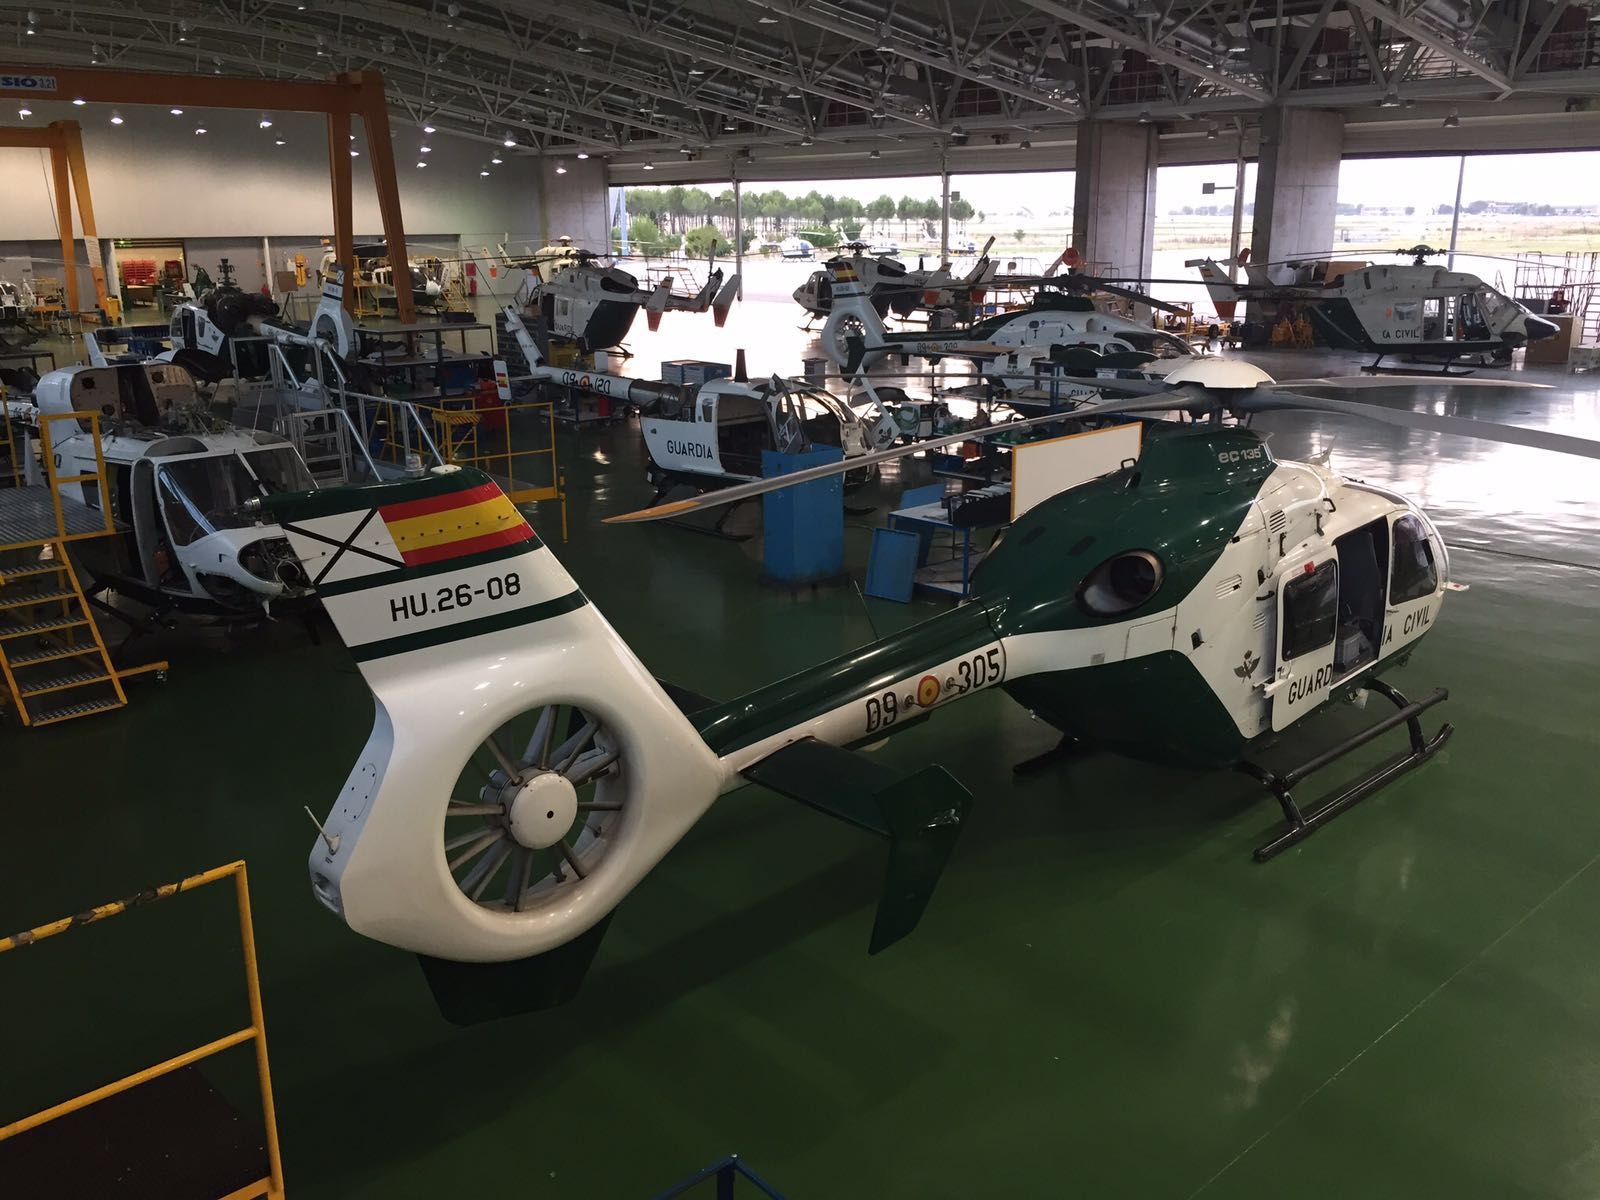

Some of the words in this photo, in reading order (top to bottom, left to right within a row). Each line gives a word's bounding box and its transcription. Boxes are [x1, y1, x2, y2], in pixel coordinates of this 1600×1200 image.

[1395, 329, 1420, 339] CIVIL
[562, 370, 576, 386] 09
[594, 377, 611, 395] 120
[666, 439, 714, 460] GUARDIA
[390, 572, 521, 622] HU.26-08
[1381, 624, 1393, 646] IA
[1403, 604, 1431, 635] CIVIL
[865, 691, 898, 733] 09
[958, 648, 1000, 695] 305
[1288, 663, 1333, 705] GUARD
